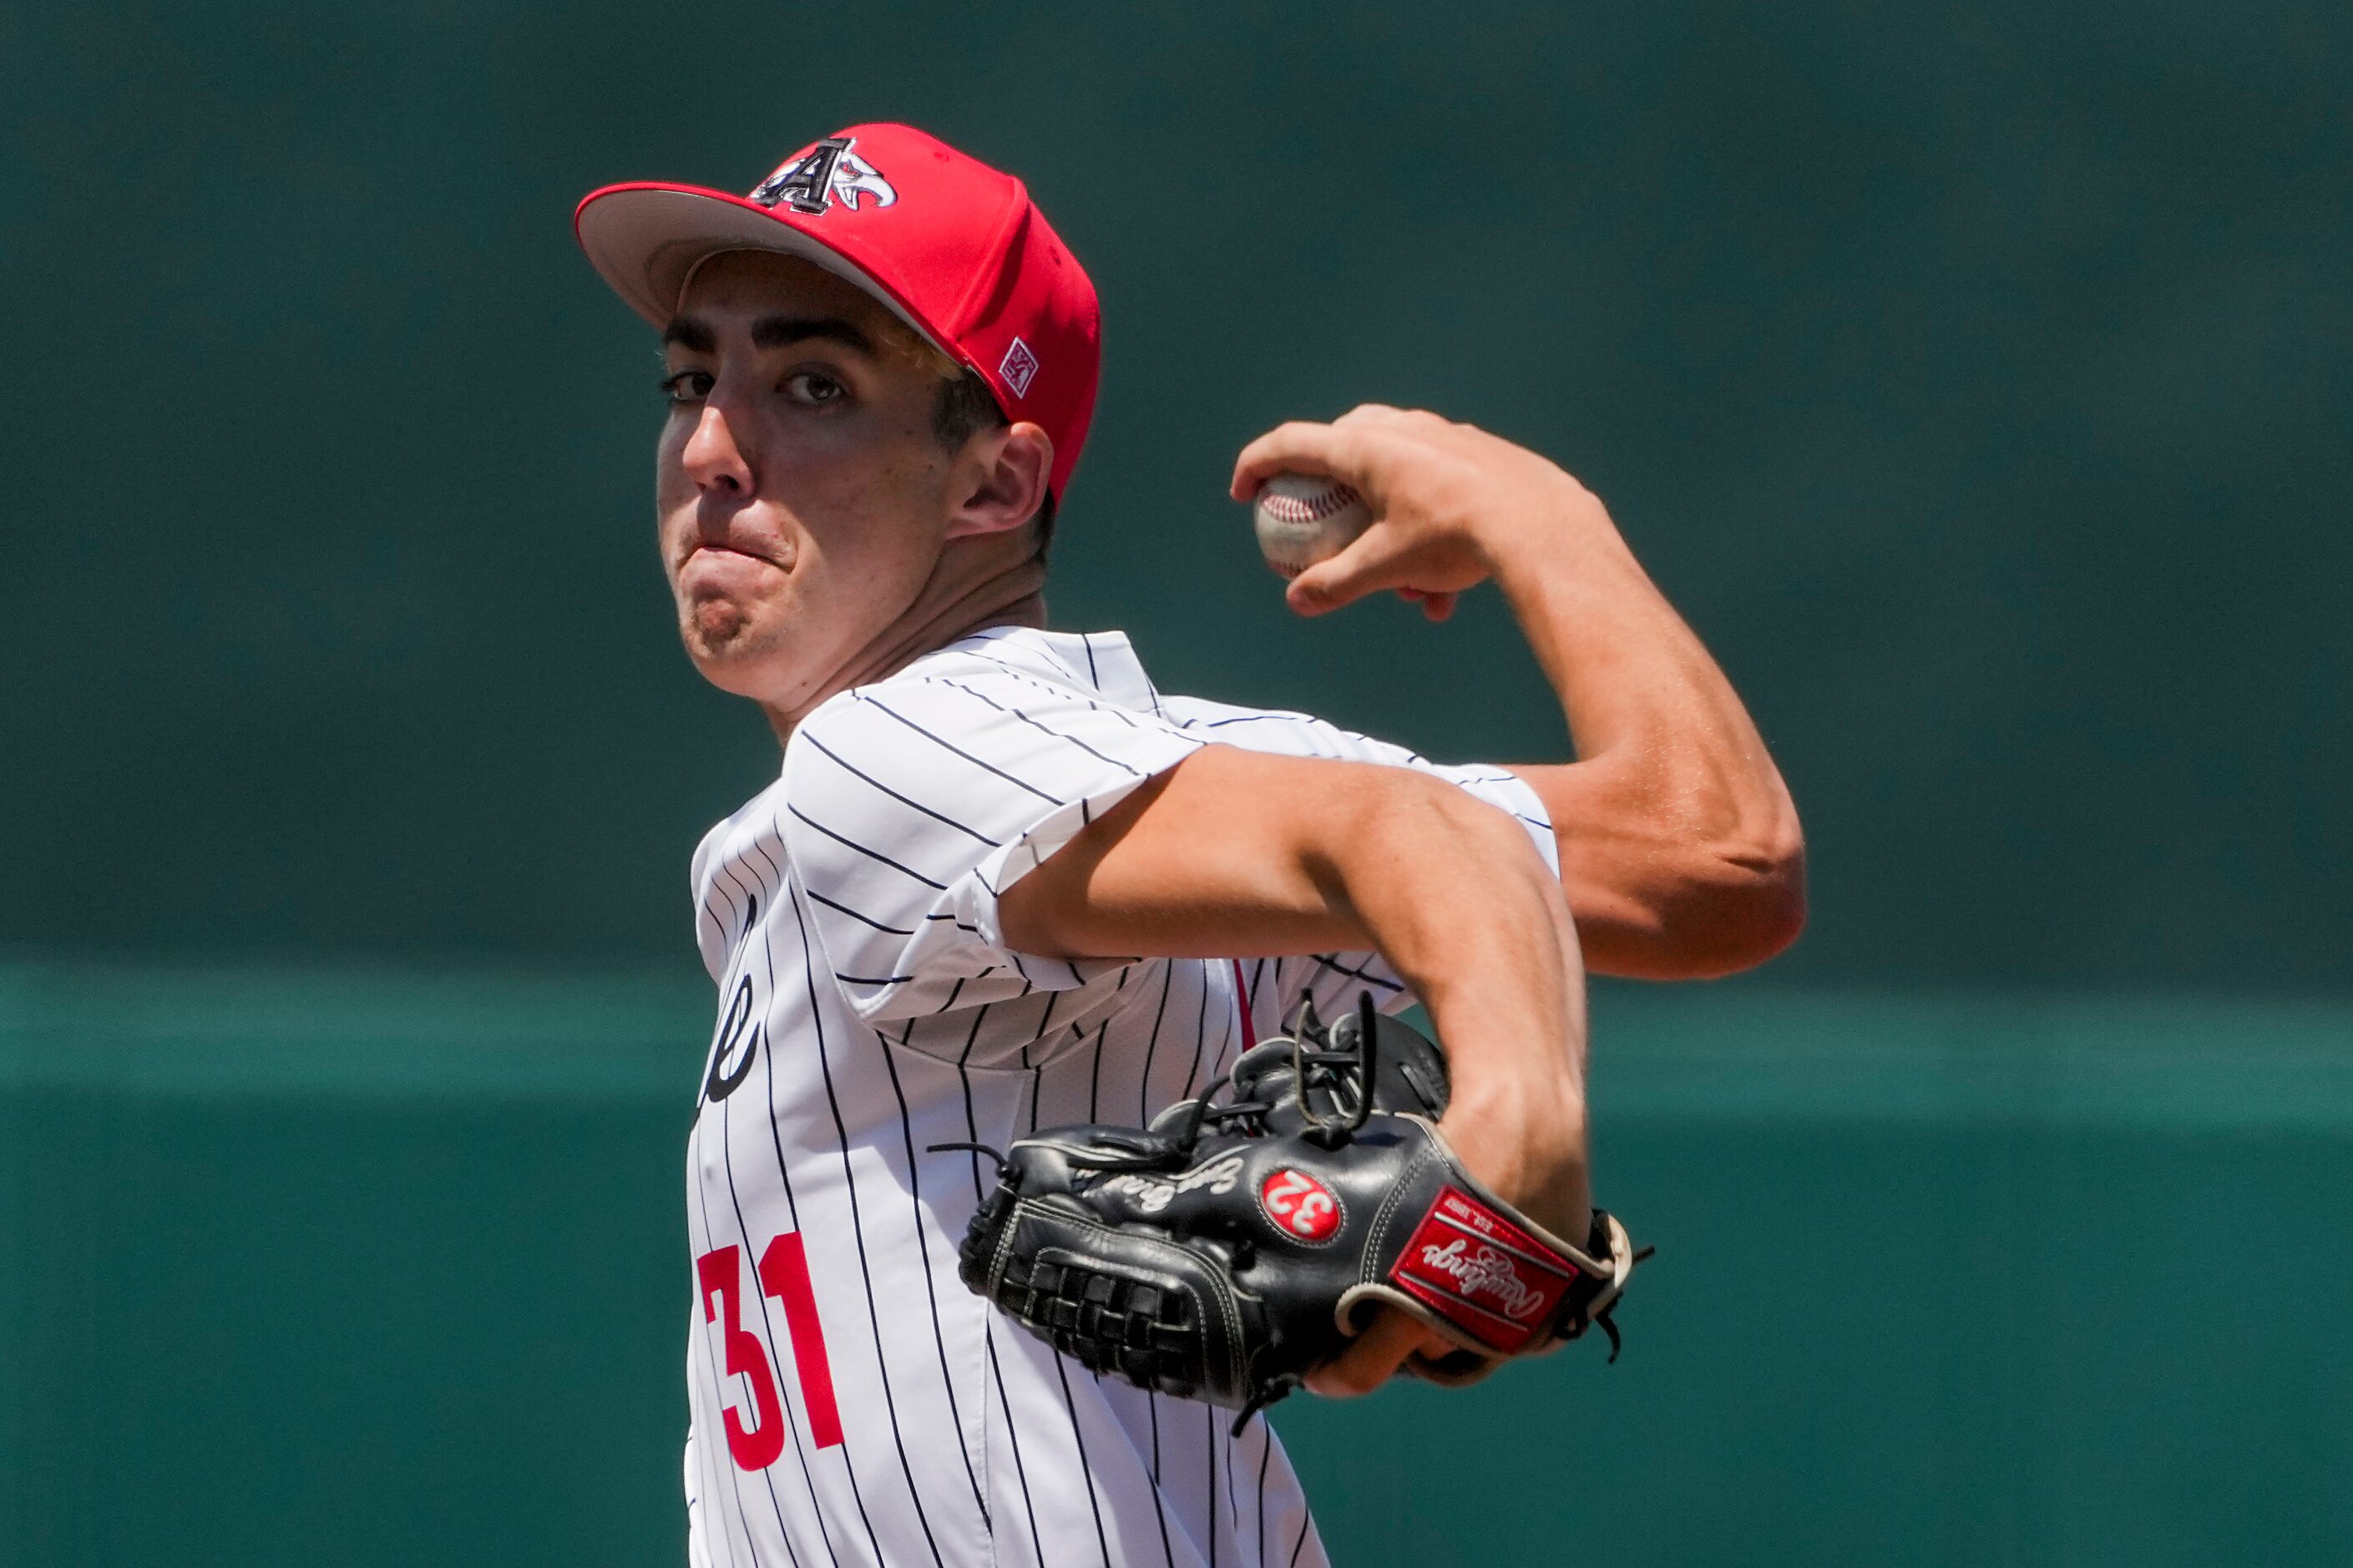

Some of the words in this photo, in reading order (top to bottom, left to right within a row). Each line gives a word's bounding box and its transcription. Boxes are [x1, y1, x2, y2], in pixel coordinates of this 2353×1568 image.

[751, 138, 857, 217] A
[1266, 1170, 1333, 1234] 32
[1422, 1239, 1544, 1318] Rawlings
[696, 1230, 846, 1472] 31
